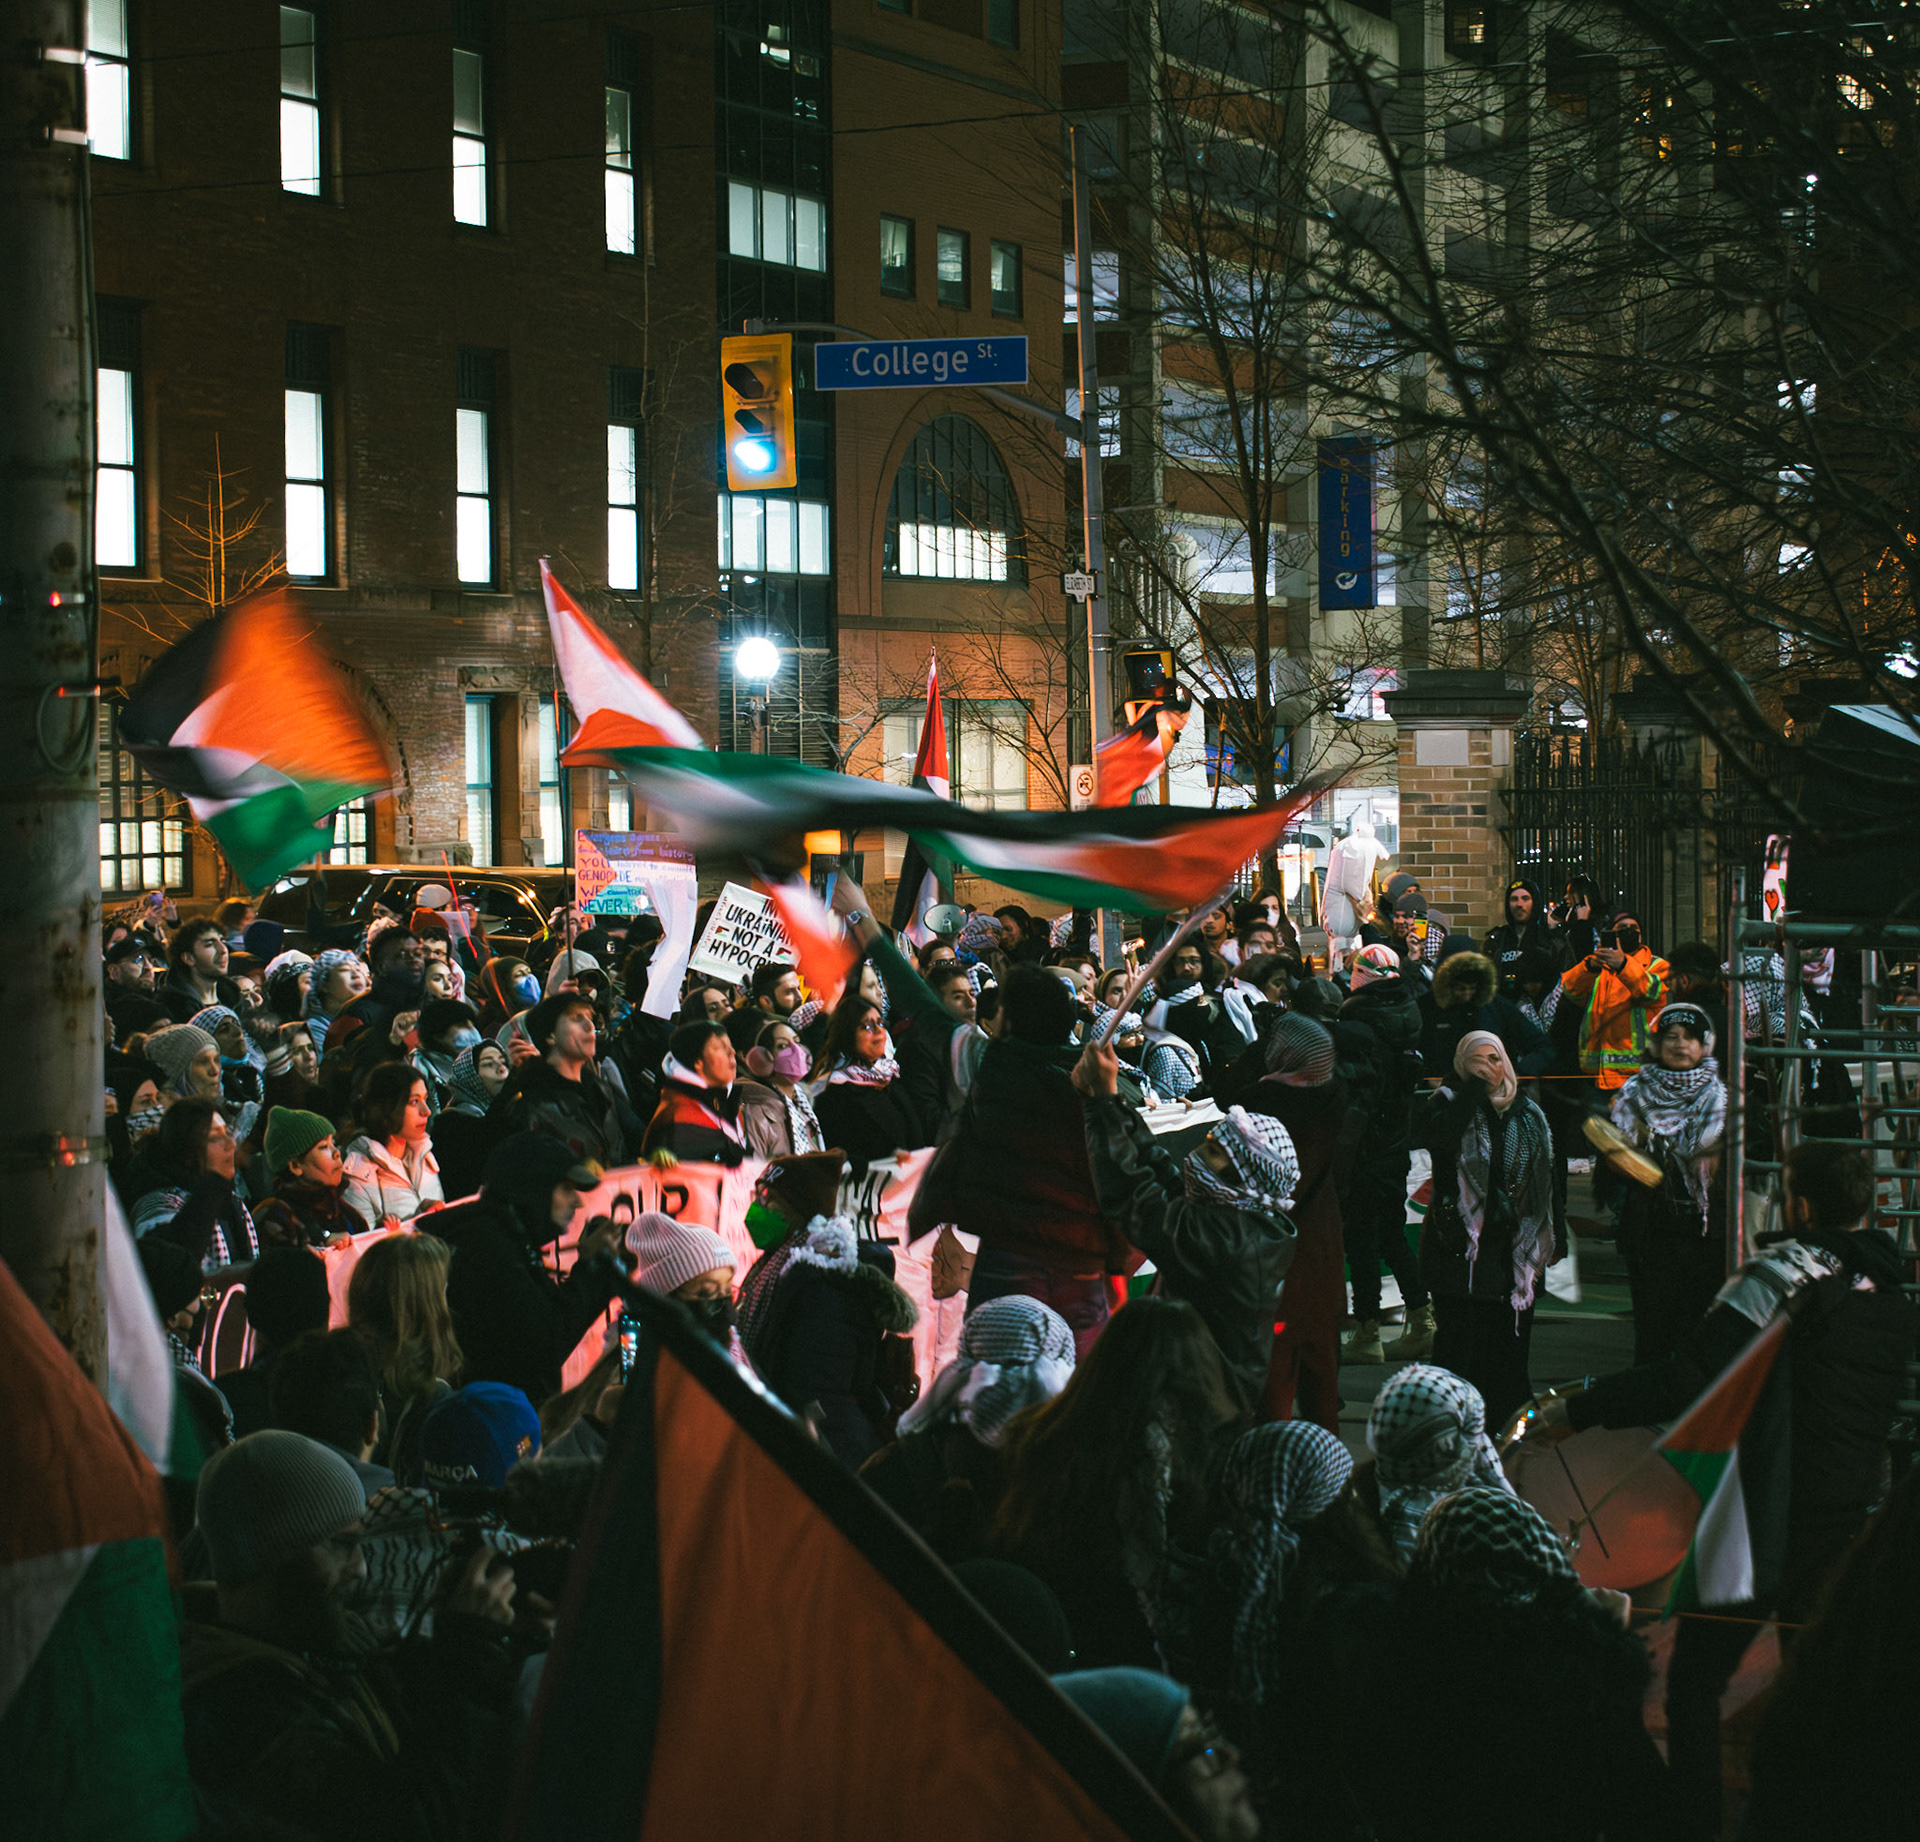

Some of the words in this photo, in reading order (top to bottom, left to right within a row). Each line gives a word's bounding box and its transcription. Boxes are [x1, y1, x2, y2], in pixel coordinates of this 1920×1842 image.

[852, 347, 968, 381] College
[578, 870, 632, 883] GENOCIDE
[580, 885, 604, 897] WE
[578, 898, 623, 913] NEVER
[731, 926, 763, 951] NOT
[763, 940, 775, 958] A
